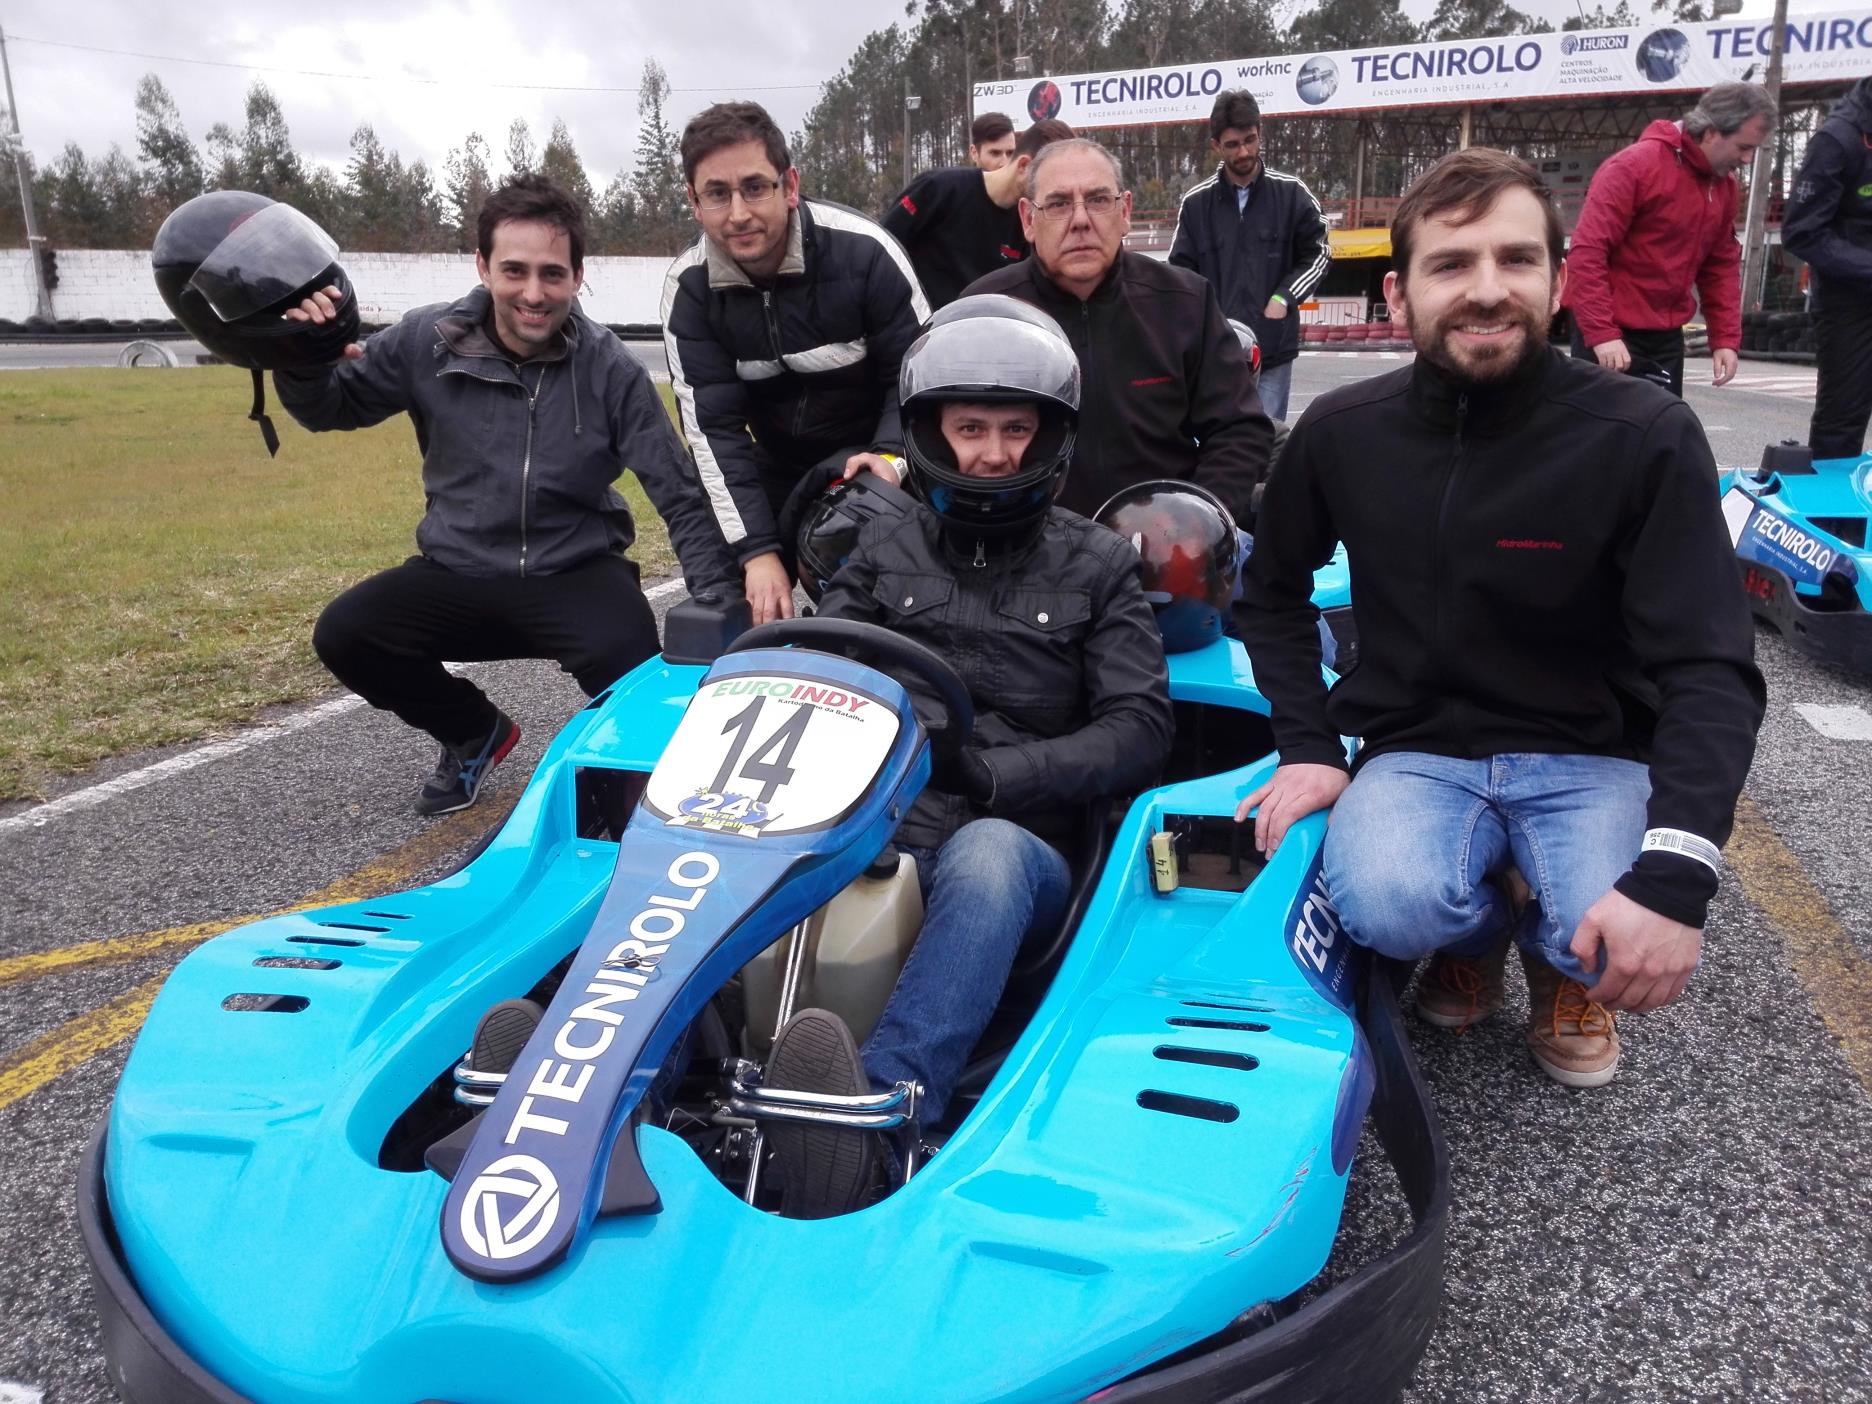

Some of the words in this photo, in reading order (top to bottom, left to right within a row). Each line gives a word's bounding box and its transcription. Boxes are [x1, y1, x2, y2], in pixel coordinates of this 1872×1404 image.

[1582, 36, 1625, 50] HURON
[1237, 60, 1292, 78] worknc
[1351, 42, 1542, 83] TECNIROLO
[1560, 60, 1593, 68] CENTROS
[1070, 69, 1222, 106] TECNIROLO
[1579, 75, 1623, 83] VELOCIDADE
[1372, 86, 1429, 97] ENGENHARIA
[1752, 509, 1831, 571] TECNIROLO
[835, 709, 865, 723] Batalha
[709, 695, 816, 804] 14
[690, 792, 753, 819] 24
[504, 851, 721, 1145] TECNIROLO
